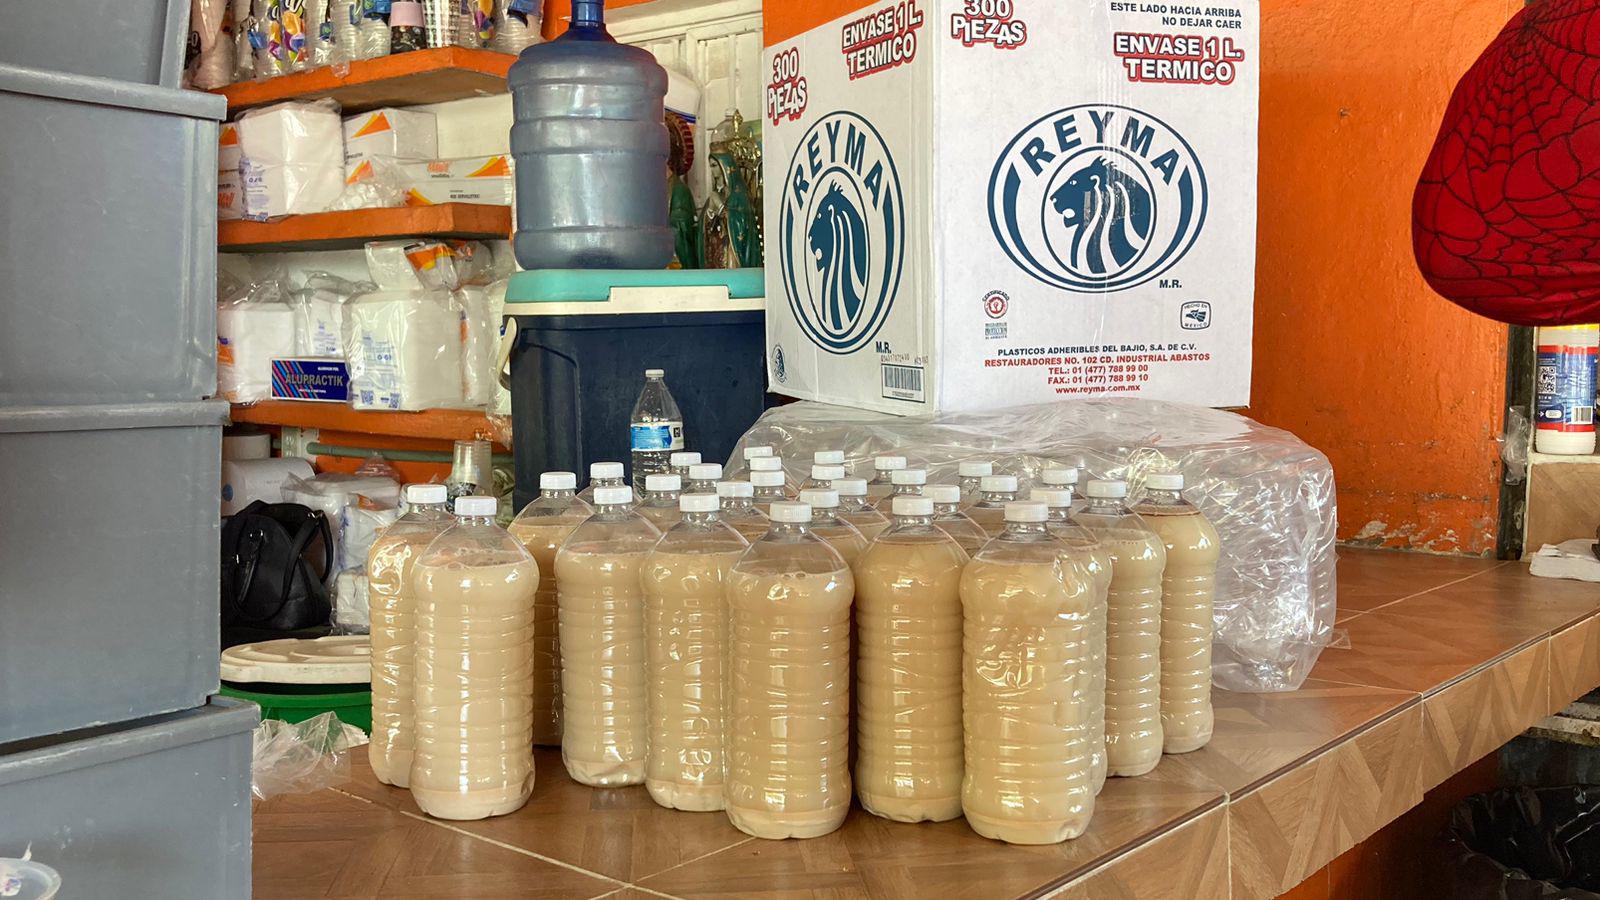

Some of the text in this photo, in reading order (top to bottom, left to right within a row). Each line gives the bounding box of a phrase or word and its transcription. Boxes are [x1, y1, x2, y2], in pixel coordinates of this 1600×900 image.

[965, 0, 1012, 18] 300
[1111, 2, 1242, 18] ESTE LADO HACIA ARRIBA
[842, 3, 922, 50] ENVASE 1 L.
[951, 14, 1026, 46] PIEZAS
[1162, 17, 1242, 29] NO DEJAR CAER
[847, 32, 916, 77] TERMICO
[1115, 34, 1242, 58] ENVASE 1 L.
[773, 49, 799, 84] 300
[1125, 57, 1233, 83] TERMICO
[767, 79, 807, 121] PIEZAS
[1020, 110, 1181, 185] REYMA
[793, 121, 882, 210] REYMA
[1159, 279, 1182, 289] M.R.
[876, 341, 891, 354] M.R.
[998, 347, 1045, 356] PLASTICOS
[1047, 346, 1100, 354] ADHERIBLES
[1121, 344, 1147, 352] BAJIO,
[984, 358, 1062, 367] RESTAURADORES
[1065, 357, 1080, 365] NO.
[1083, 356, 1097, 364] 102
[1116, 354, 1168, 363] INDUSTRIAL
[1170, 353, 1210, 362] ABASTOS
[1048, 367, 1070, 375] TEL.:
[1072, 366, 1082, 374] 01
[1084, 366, 1106, 375] (477)
[1109, 365, 1123, 373] 788
[1138, 364, 1148, 372] 00
[286, 374, 343, 386] ALUPRACTIK
[1048, 373, 1148, 385] FAX.: 01 (477) 788 99 10
[1056, 384, 1140, 394] www.reyma.com.mx
